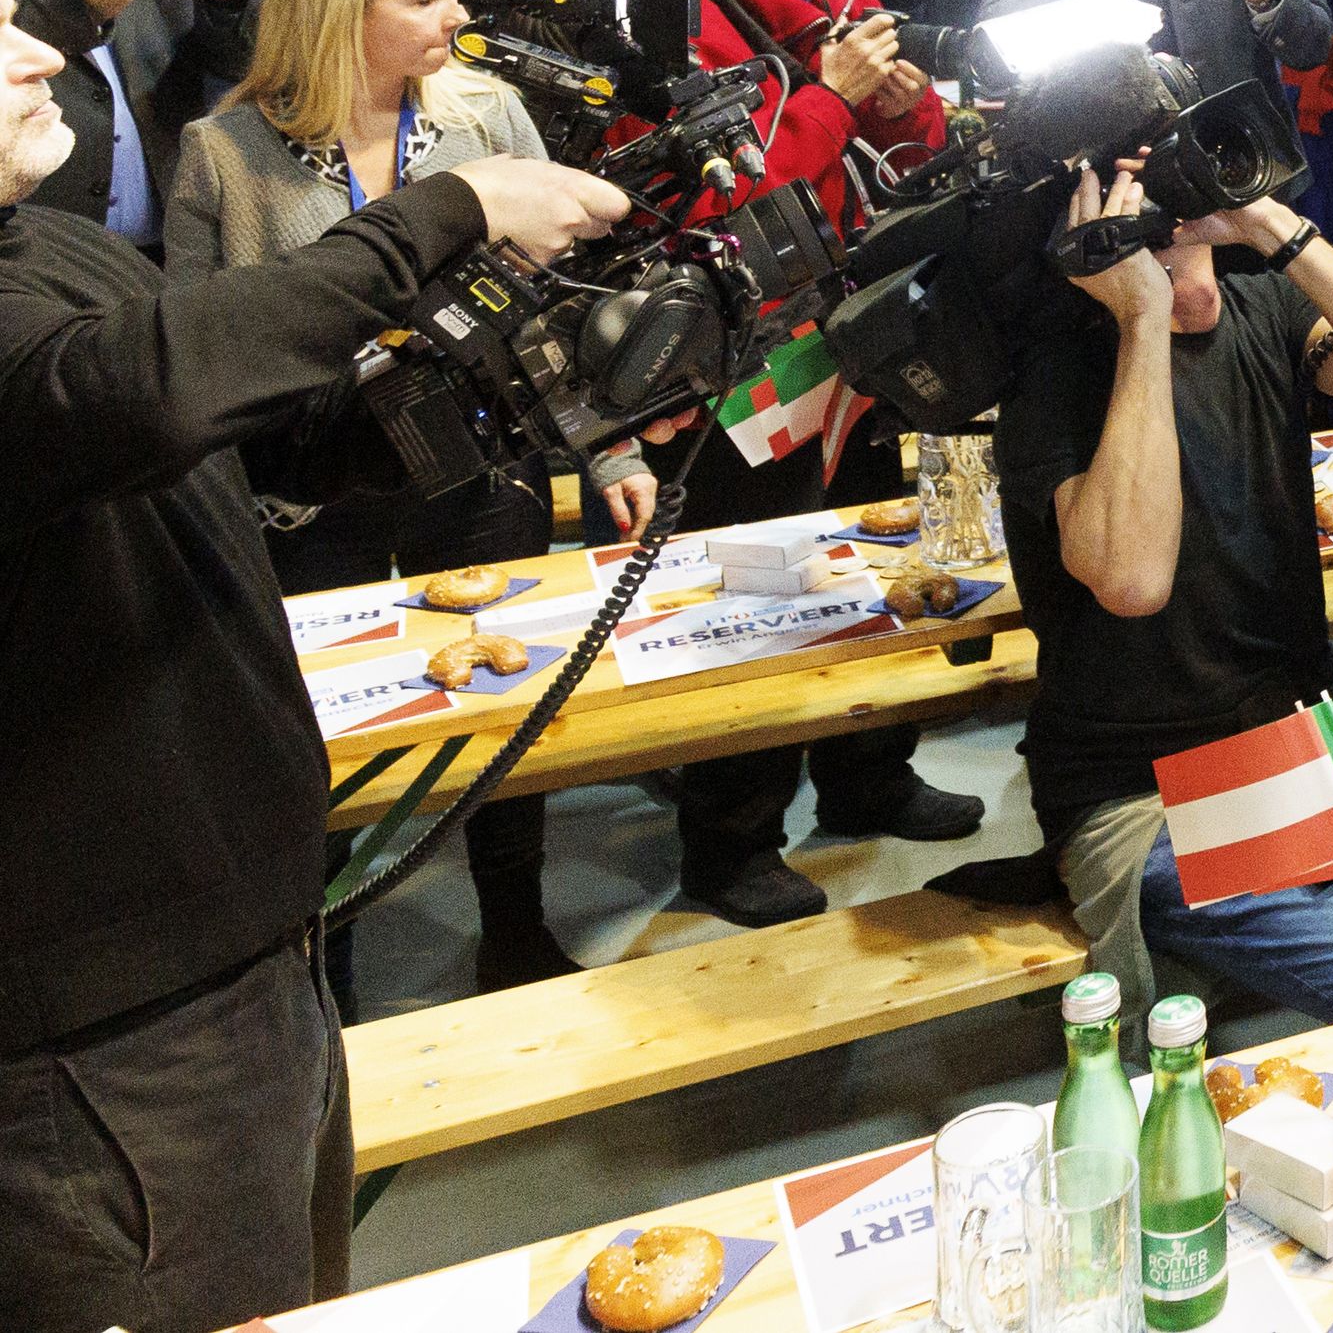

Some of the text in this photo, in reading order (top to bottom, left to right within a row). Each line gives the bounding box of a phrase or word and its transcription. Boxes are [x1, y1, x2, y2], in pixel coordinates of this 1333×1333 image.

[448, 303, 479, 329] SONY
[645, 334, 680, 381] SONY
[640, 600, 863, 652] RESERVIERT
[697, 635, 747, 650] Erwin
[1150, 1265, 1207, 1285] QUELLE
